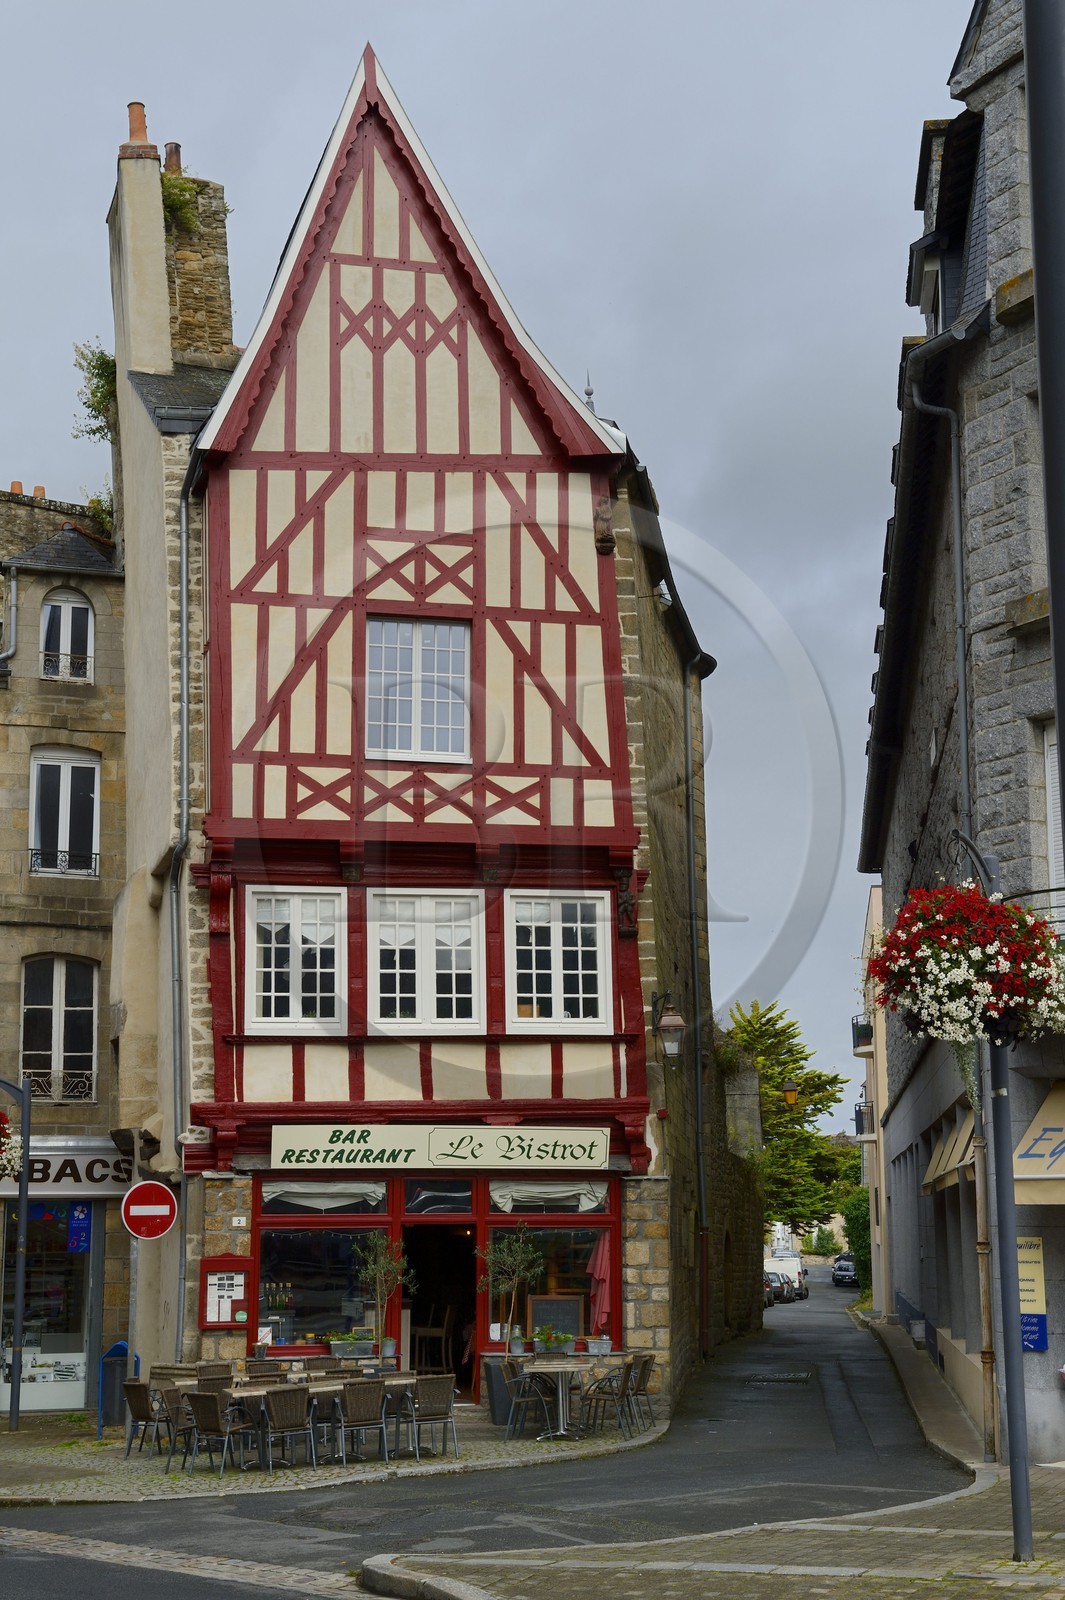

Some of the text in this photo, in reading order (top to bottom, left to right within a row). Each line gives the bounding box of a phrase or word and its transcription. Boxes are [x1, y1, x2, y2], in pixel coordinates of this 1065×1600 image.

[328, 1129, 371, 1144] BAR
[435, 1135, 598, 1160] Le Bistrot
[281, 1148, 416, 1163] RESTAURANT
[0, 1158, 132, 1183] BACS
[1016, 1241, 1041, 1250] uilibre
